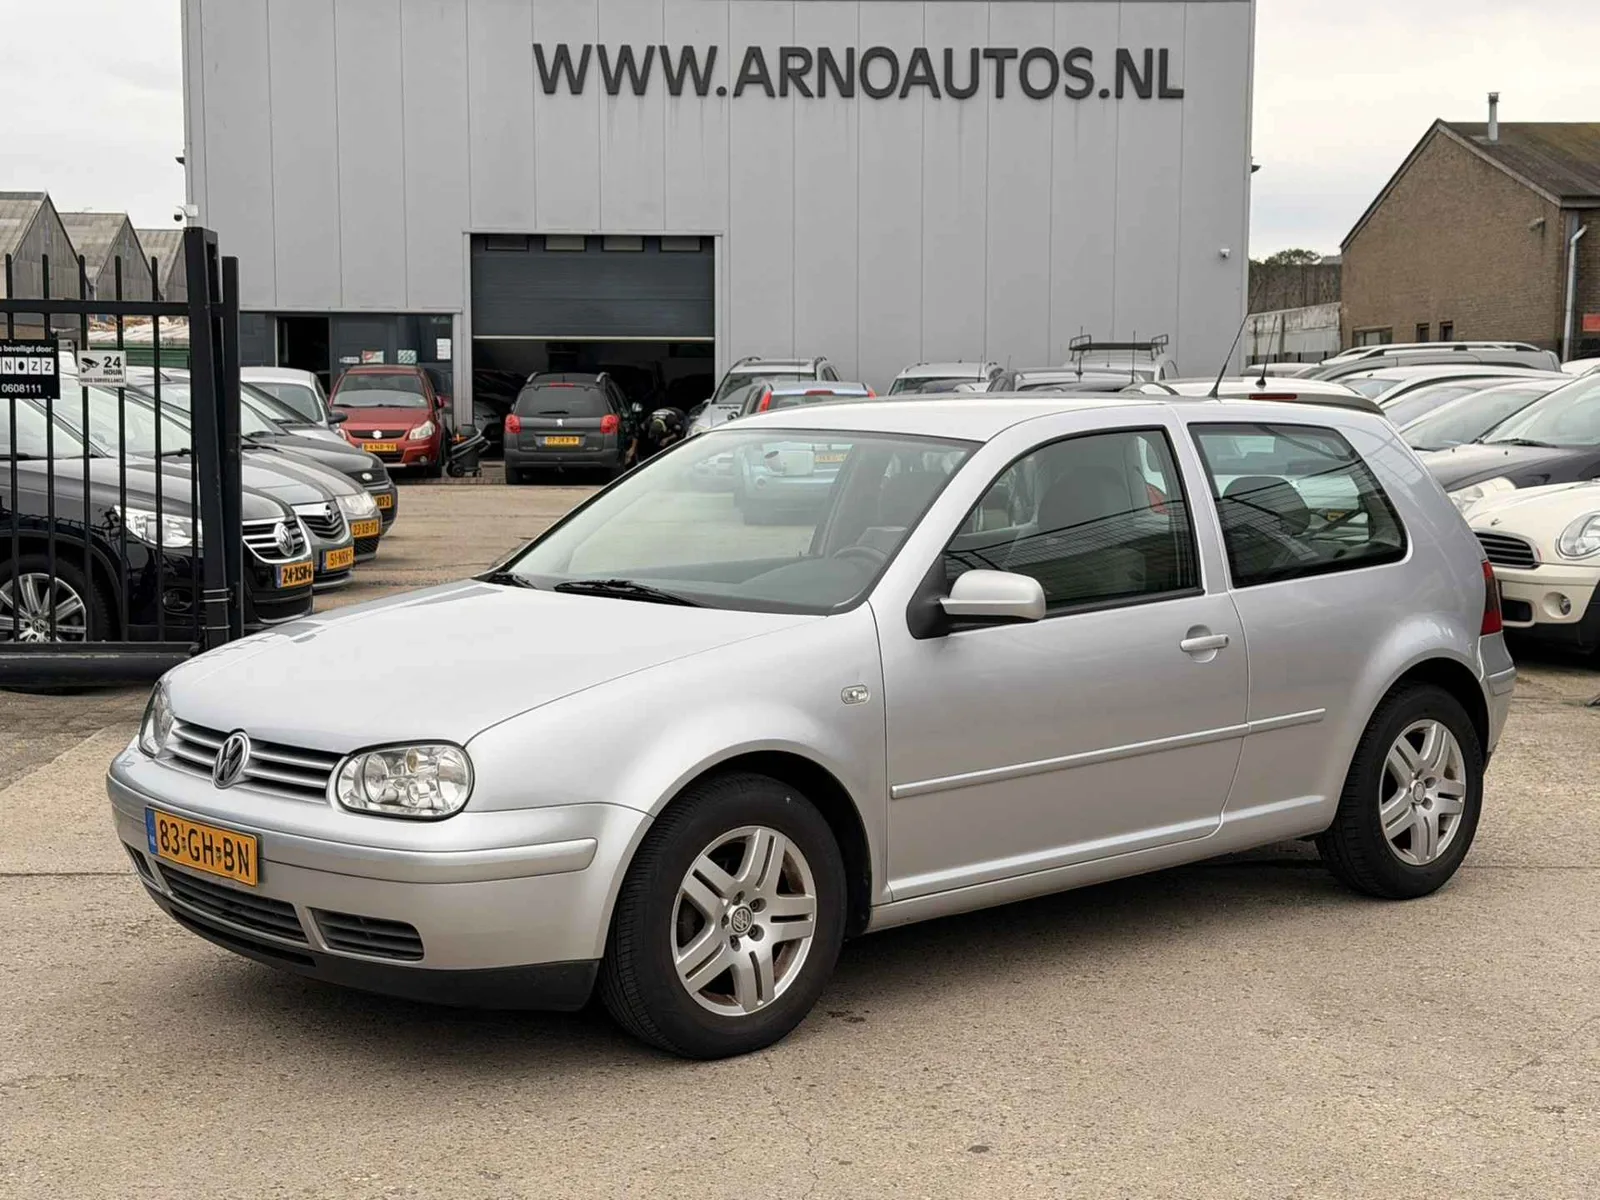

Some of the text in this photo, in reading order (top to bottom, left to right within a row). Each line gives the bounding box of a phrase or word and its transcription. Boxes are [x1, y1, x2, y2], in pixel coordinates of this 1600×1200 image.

[533, 43, 1184, 100] WWW.ARNOAUTOS.NL
[103, 355, 122, 369] 24
[1, 383, 42, 393] 0608111
[159, 819, 250, 877] 83-GH-BN
